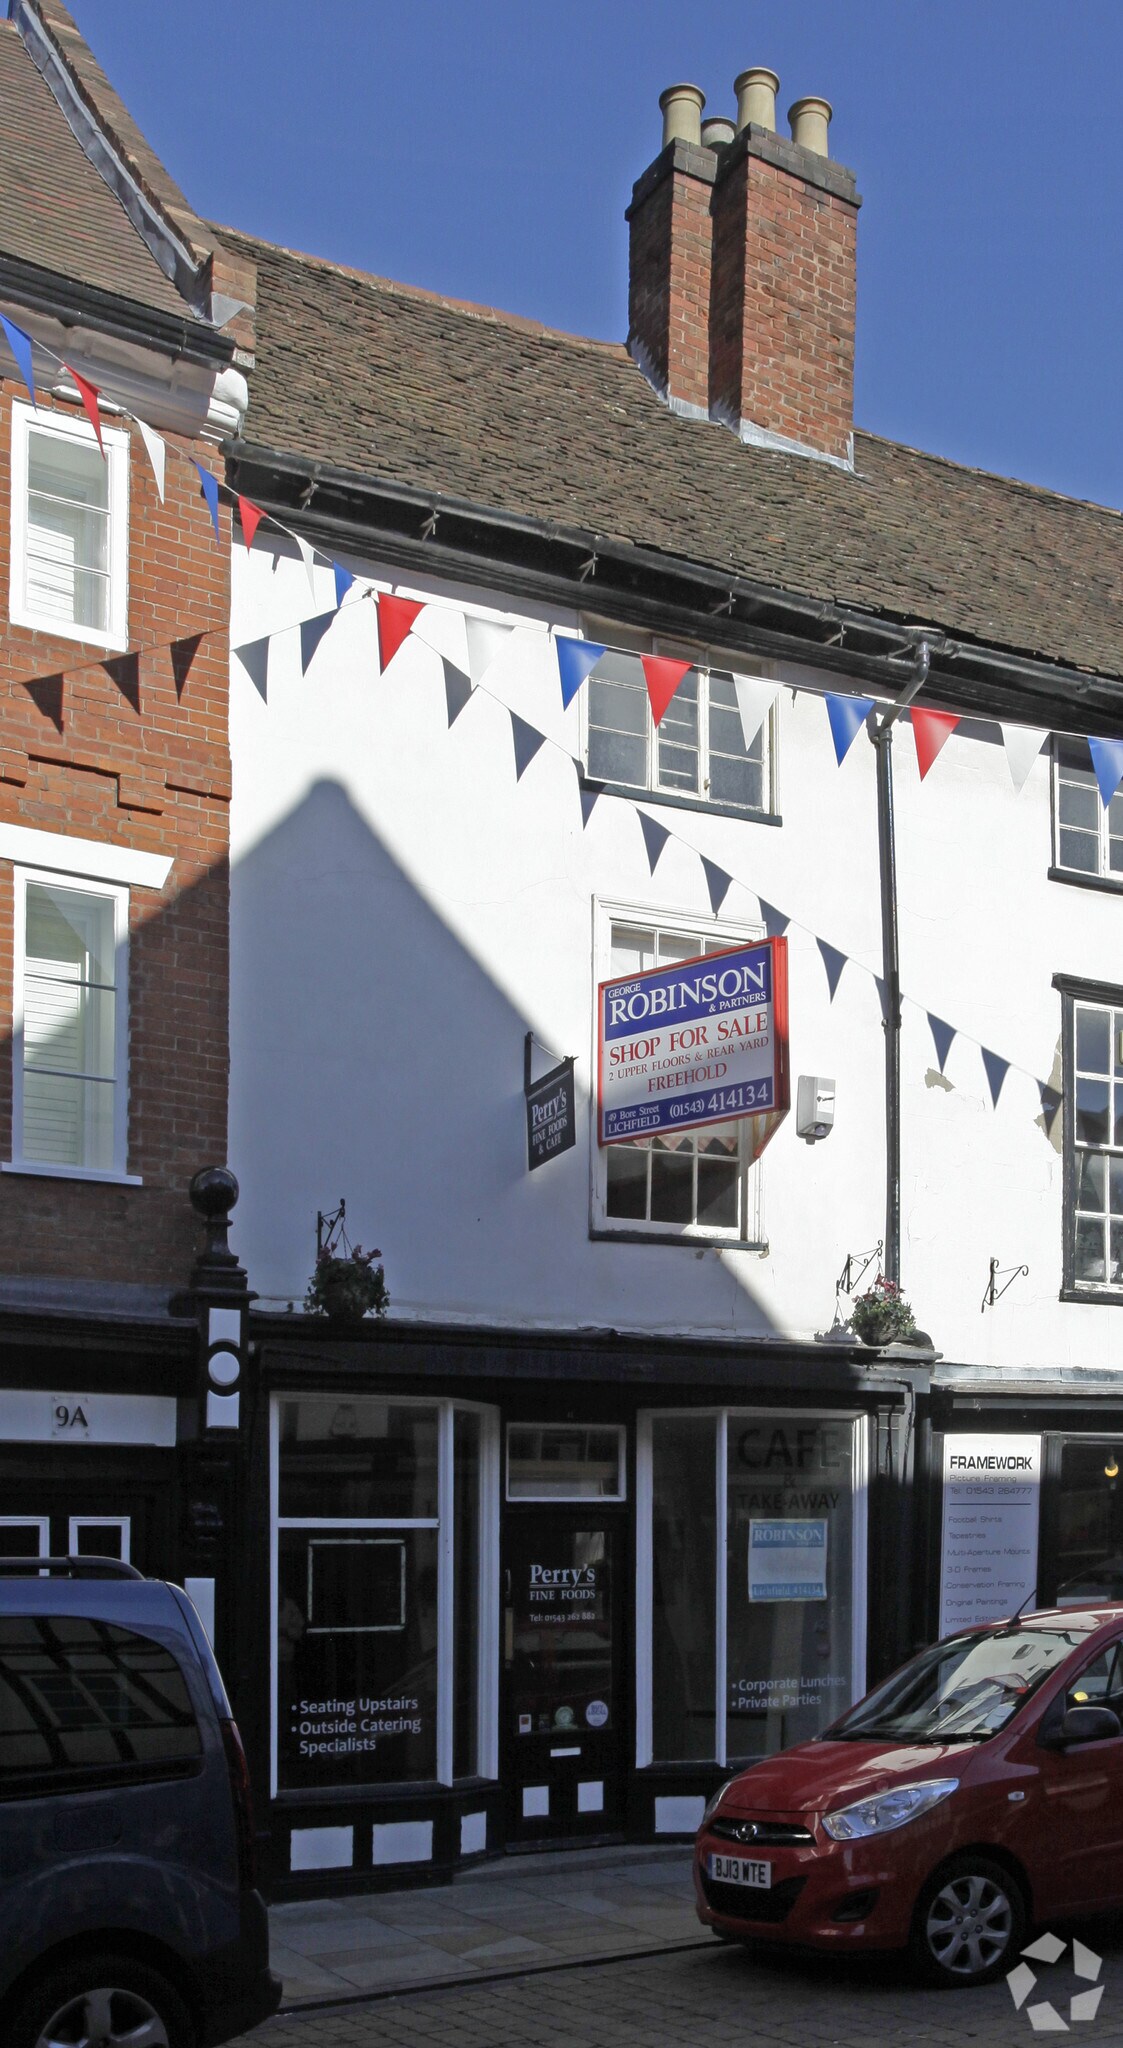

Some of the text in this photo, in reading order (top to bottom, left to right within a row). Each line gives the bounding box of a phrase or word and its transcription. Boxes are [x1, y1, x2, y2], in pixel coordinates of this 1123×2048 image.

[608, 982, 641, 999] GEORGE
[608, 961, 766, 1026] ROBINSON
[708, 991, 767, 1013] & PARTNERS
[609, 1011, 768, 1067] SHOP FOR SALE
[608, 1036, 769, 1081] 2 UPPER FLOORS & REAR YARD
[647, 1062, 728, 1093] FREEHOLD
[531, 1087, 567, 1127] Perry's
[608, 1083, 769, 1122] 49 Bore Street (01543) 414134
[532, 1115, 568, 1147] FINE FOODS
[608, 1114, 661, 1134] LICHFIELD
[538, 1143, 544, 1155] &
[55, 1405, 88, 1427] 9A
[737, 1428, 841, 1468] CAFE
[950, 1455, 1033, 1470] FRAMEWORK
[783, 1472, 797, 1489] &
[950, 1474, 1017, 1485] Picture Framing
[966, 1487, 994, 1495] 01543
[948, 1516, 977, 1524] Football
[754, 1529, 823, 1542] ROBINSON
[948, 1532, 986, 1541] Tapestries
[1003, 1548, 1031, 1556] Mounts
[530, 1563, 596, 1588] Perry's
[530, 1589, 596, 1601] FINE FOODS
[945, 1581, 1026, 1590] Conservation Framing
[945, 1598, 1008, 1608] Original Paintings
[530, 1612, 596, 1623] Tel: 01543 262 882
[945, 1616, 972, 1624] Limited
[738, 1673, 847, 1693] Corporate Lunches
[299, 1696, 419, 1716] Seating Upstairs
[738, 1693, 822, 1709] Private Parties
[299, 1716, 422, 1735] Outside Catering
[299, 1737, 377, 1758] Specialists
[716, 1857, 767, 1884] BJ13 WTE
